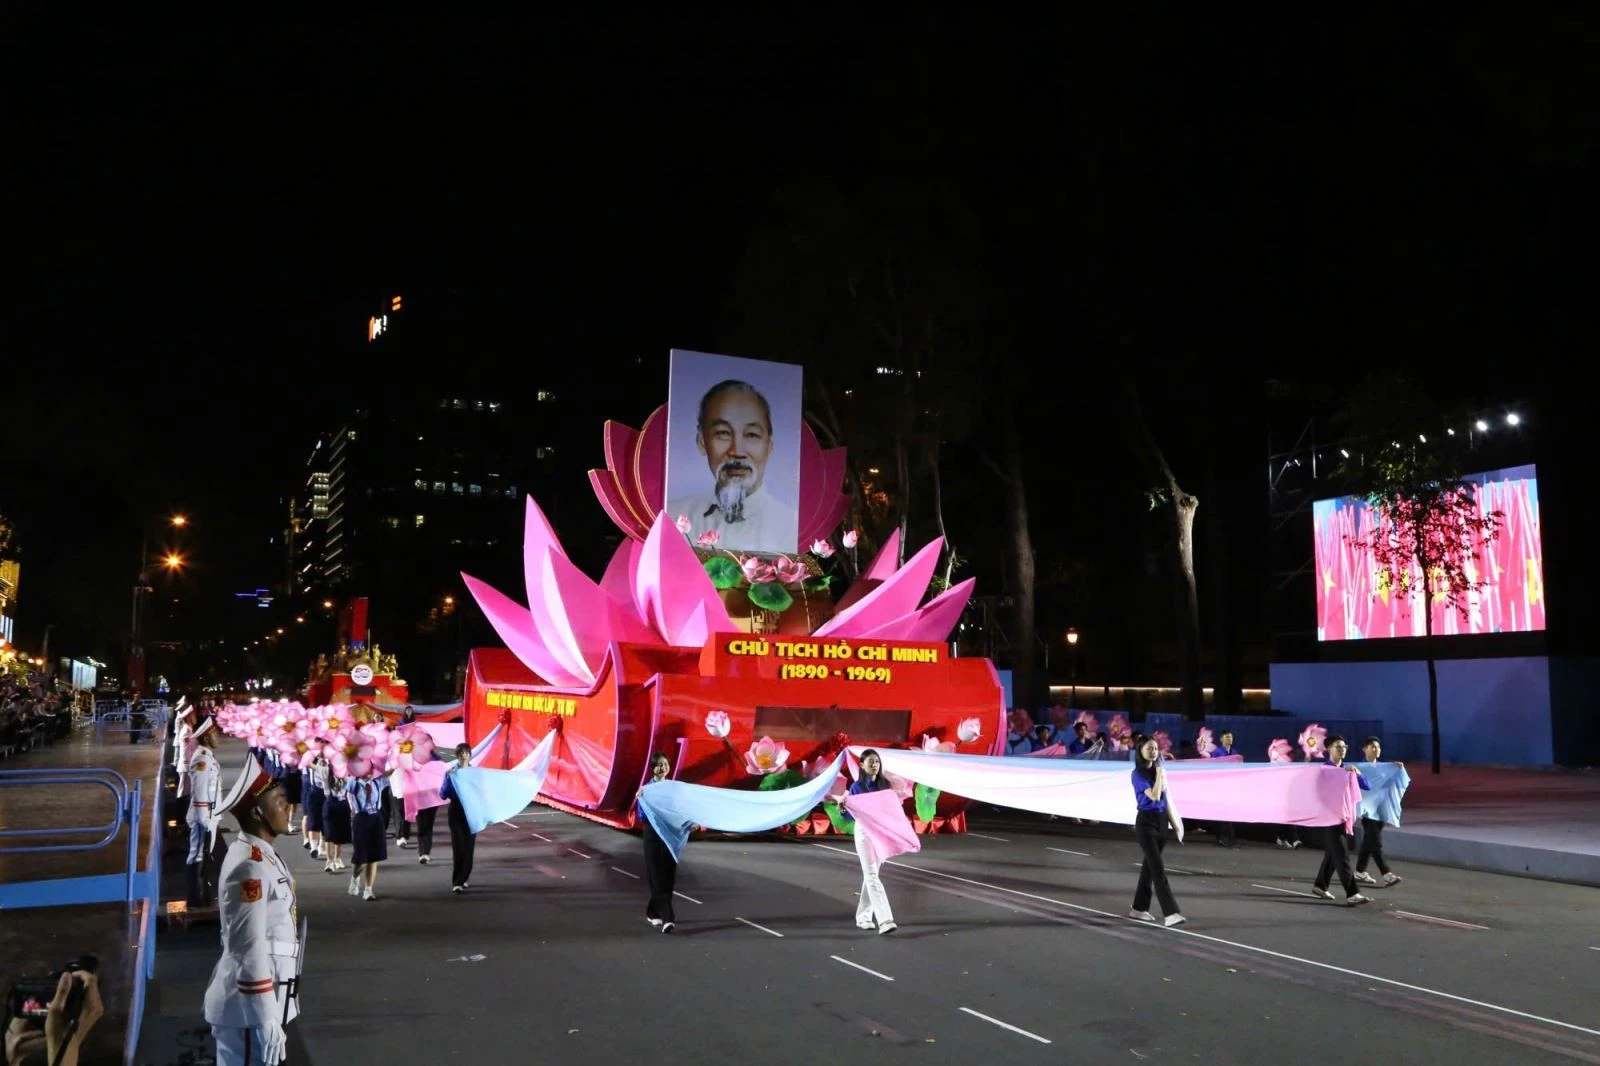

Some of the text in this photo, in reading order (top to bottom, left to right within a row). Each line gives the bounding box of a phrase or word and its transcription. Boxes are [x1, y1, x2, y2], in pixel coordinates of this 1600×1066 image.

[729, 638, 938, 663] CHỦ TỊCH HỒ CHÍ MINH
[781, 664, 829, 680] (1890
[846, 666, 891, 684] 1969)
